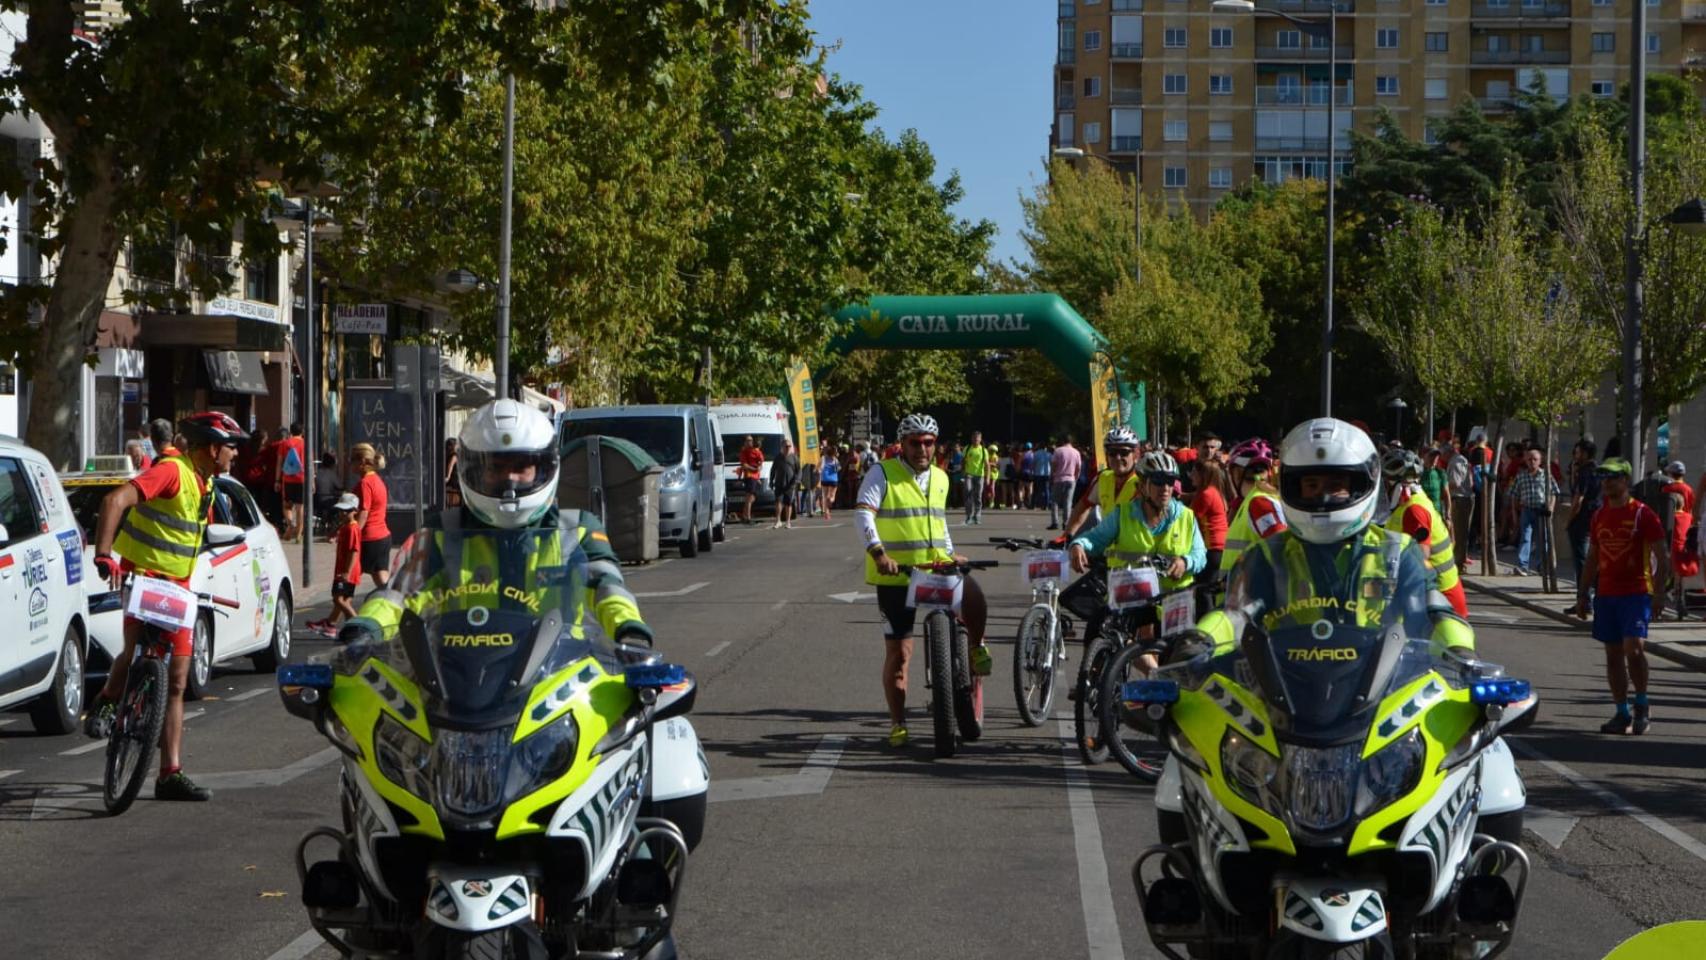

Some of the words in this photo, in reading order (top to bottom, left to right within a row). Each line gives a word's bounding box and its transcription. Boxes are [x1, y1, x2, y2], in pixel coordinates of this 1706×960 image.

[899, 315, 950, 333] CAJA
[956, 313, 1030, 332] RURAL
[362, 399, 385, 415] LA
[363, 421, 406, 437] VEN-
[374, 442, 415, 459] ANA
[1287, 646, 1358, 661] TRÁFICO
